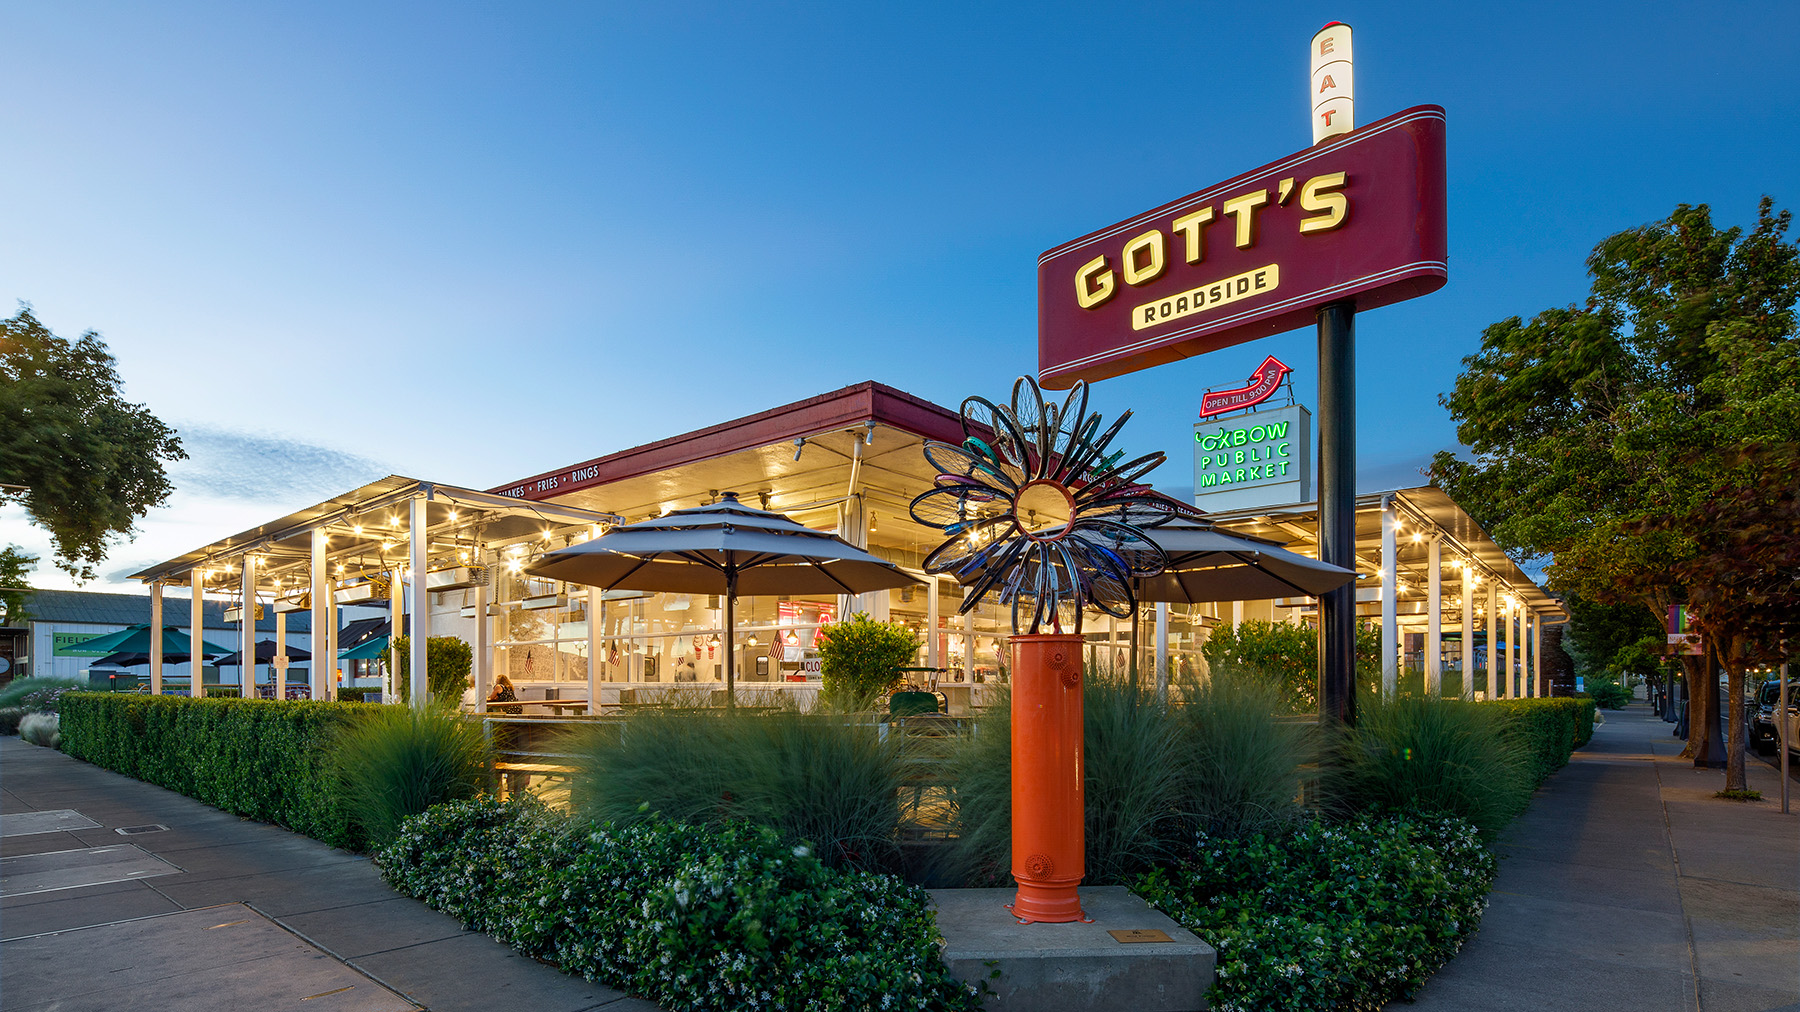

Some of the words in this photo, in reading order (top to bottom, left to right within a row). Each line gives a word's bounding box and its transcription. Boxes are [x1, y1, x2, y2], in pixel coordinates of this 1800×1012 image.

[1320, 37, 1336, 127] EAT
[1075, 171, 1349, 310] GOTT'S
[1144, 271, 1267, 324] ROADSIDE
[1205, 397, 1229, 409] OPEN
[1231, 394, 1248, 404] TILL
[1249, 385, 1267, 399] 9:00
[1264, 369, 1276, 385] PM
[1201, 442, 1290, 470] PUBLIC
[537, 476, 559, 492] FRIES
[572, 465, 600, 482] RINGS
[1201, 461, 1290, 488] MARKET
[805, 660, 823, 673] CLO
